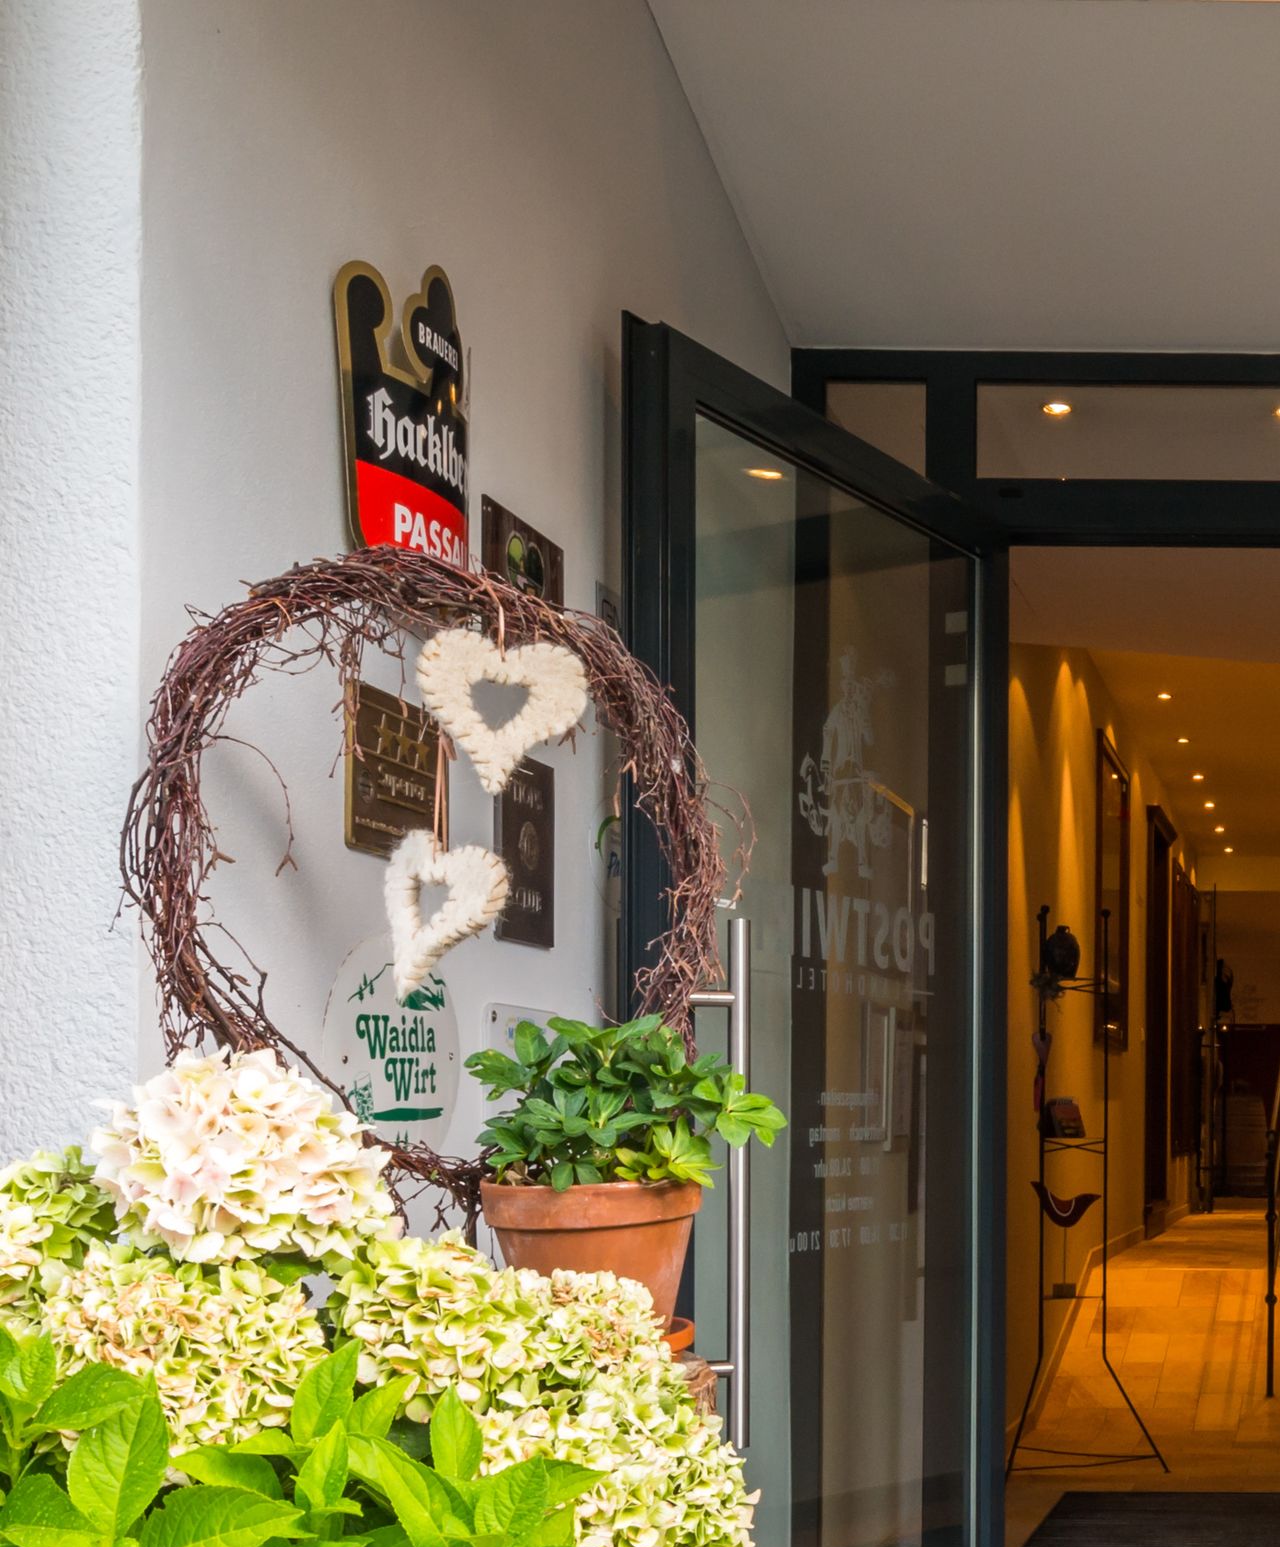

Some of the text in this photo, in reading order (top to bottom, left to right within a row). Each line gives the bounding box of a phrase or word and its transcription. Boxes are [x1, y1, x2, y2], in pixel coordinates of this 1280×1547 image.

[417, 320, 459, 372] BRAUEREI
[355, 1013, 437, 1060] Waidla
[384, 1057, 437, 1101] Wirt
